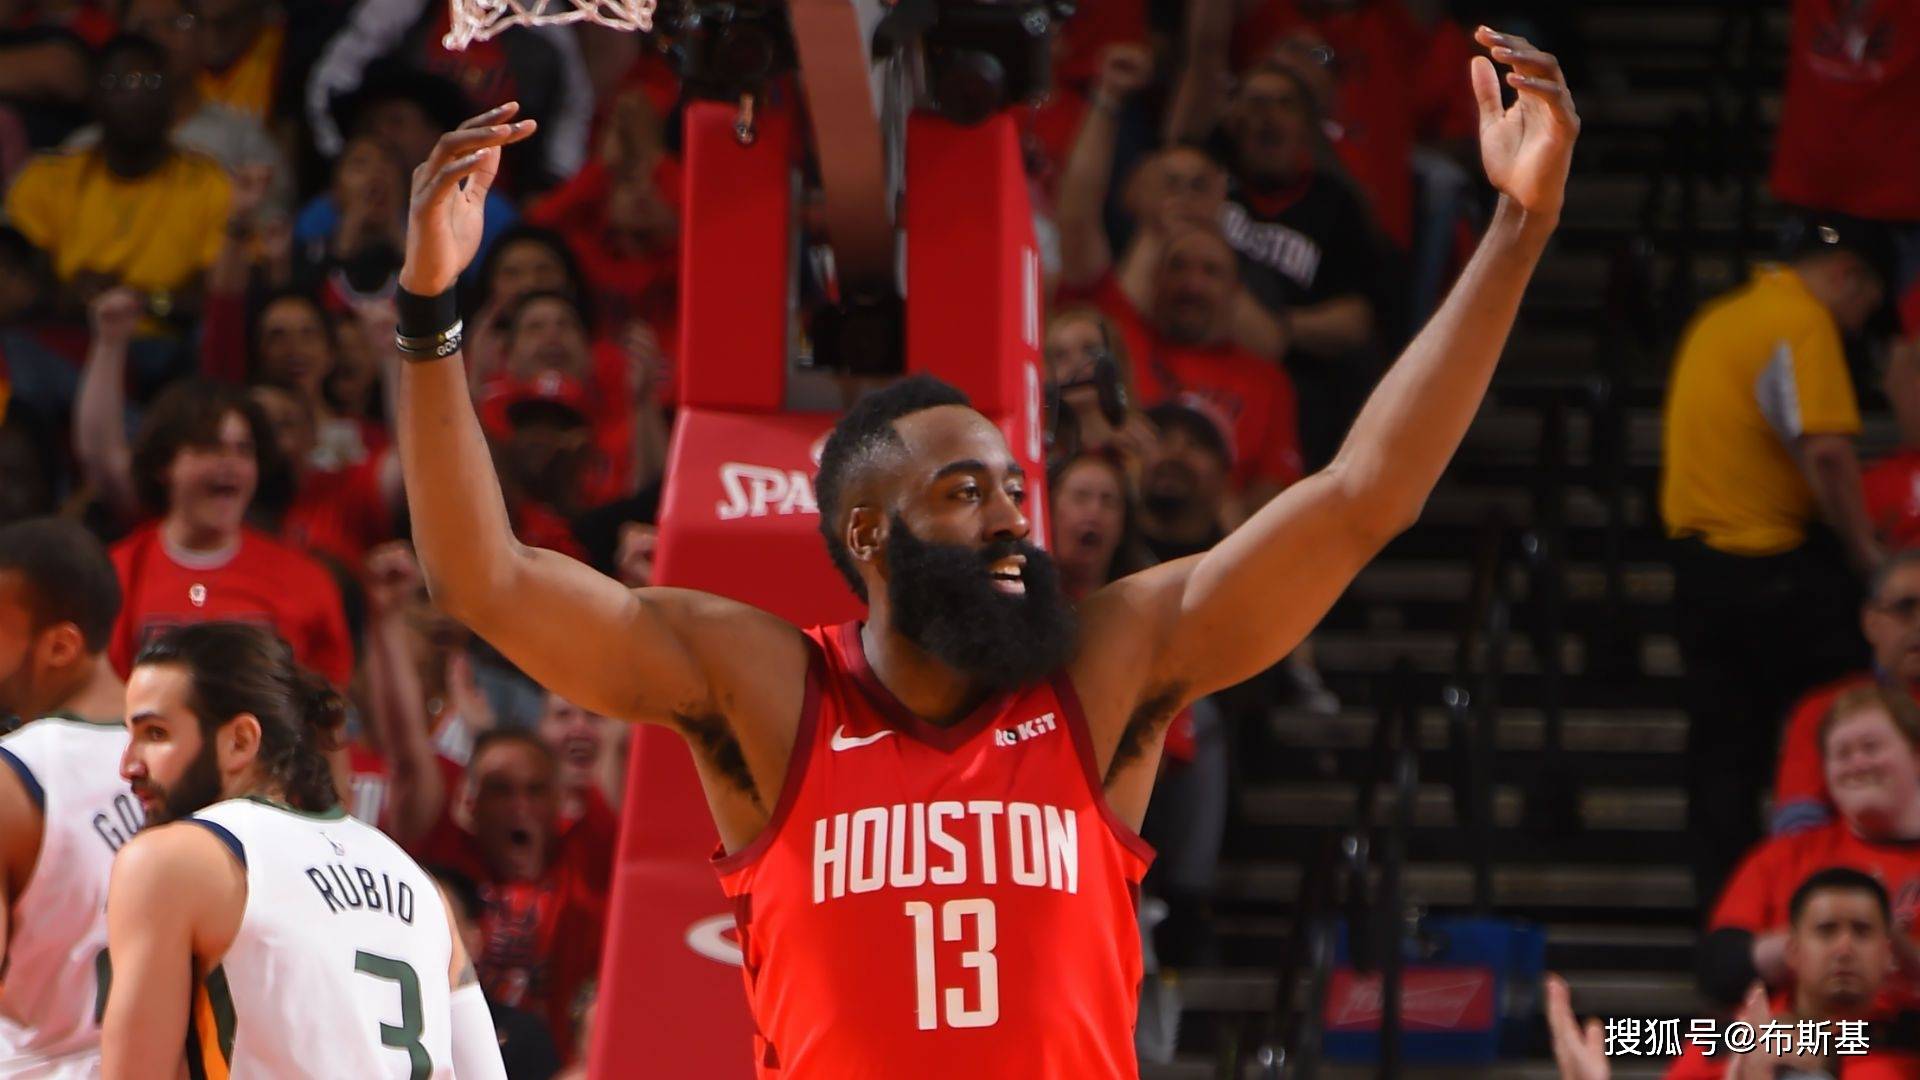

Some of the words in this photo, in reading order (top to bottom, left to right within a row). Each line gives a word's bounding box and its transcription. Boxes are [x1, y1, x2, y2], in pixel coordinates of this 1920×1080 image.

[305, 864, 415, 925] RUBIO
[813, 801, 1078, 903] HOUSTON
[354, 949, 433, 1080] 3
[905, 898, 999, 1030] 13
